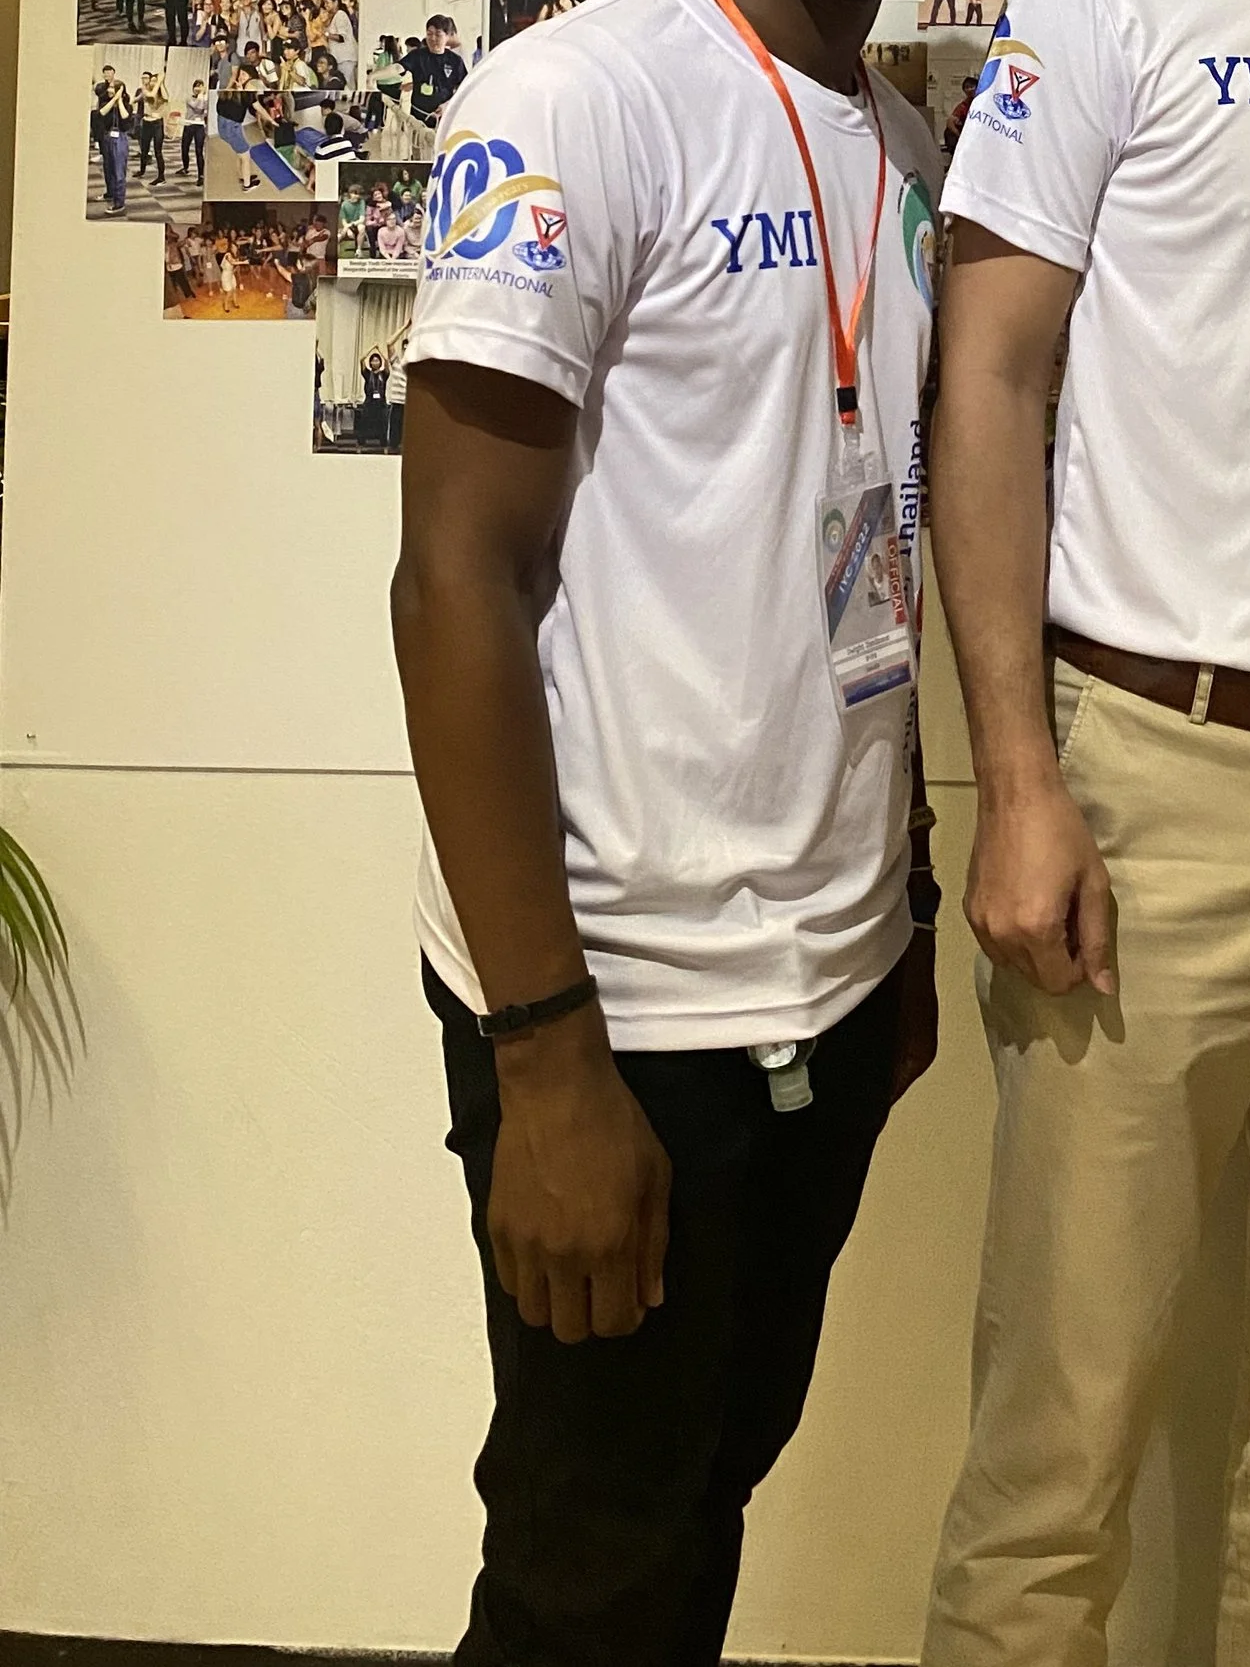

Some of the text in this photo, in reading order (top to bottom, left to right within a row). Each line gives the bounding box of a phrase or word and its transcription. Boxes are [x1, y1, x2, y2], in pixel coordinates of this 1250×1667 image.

[969, 108, 1024, 145] NATIONAL
[711, 210, 818, 274] YMI
[887, 542, 906, 615] OFFICIAL
